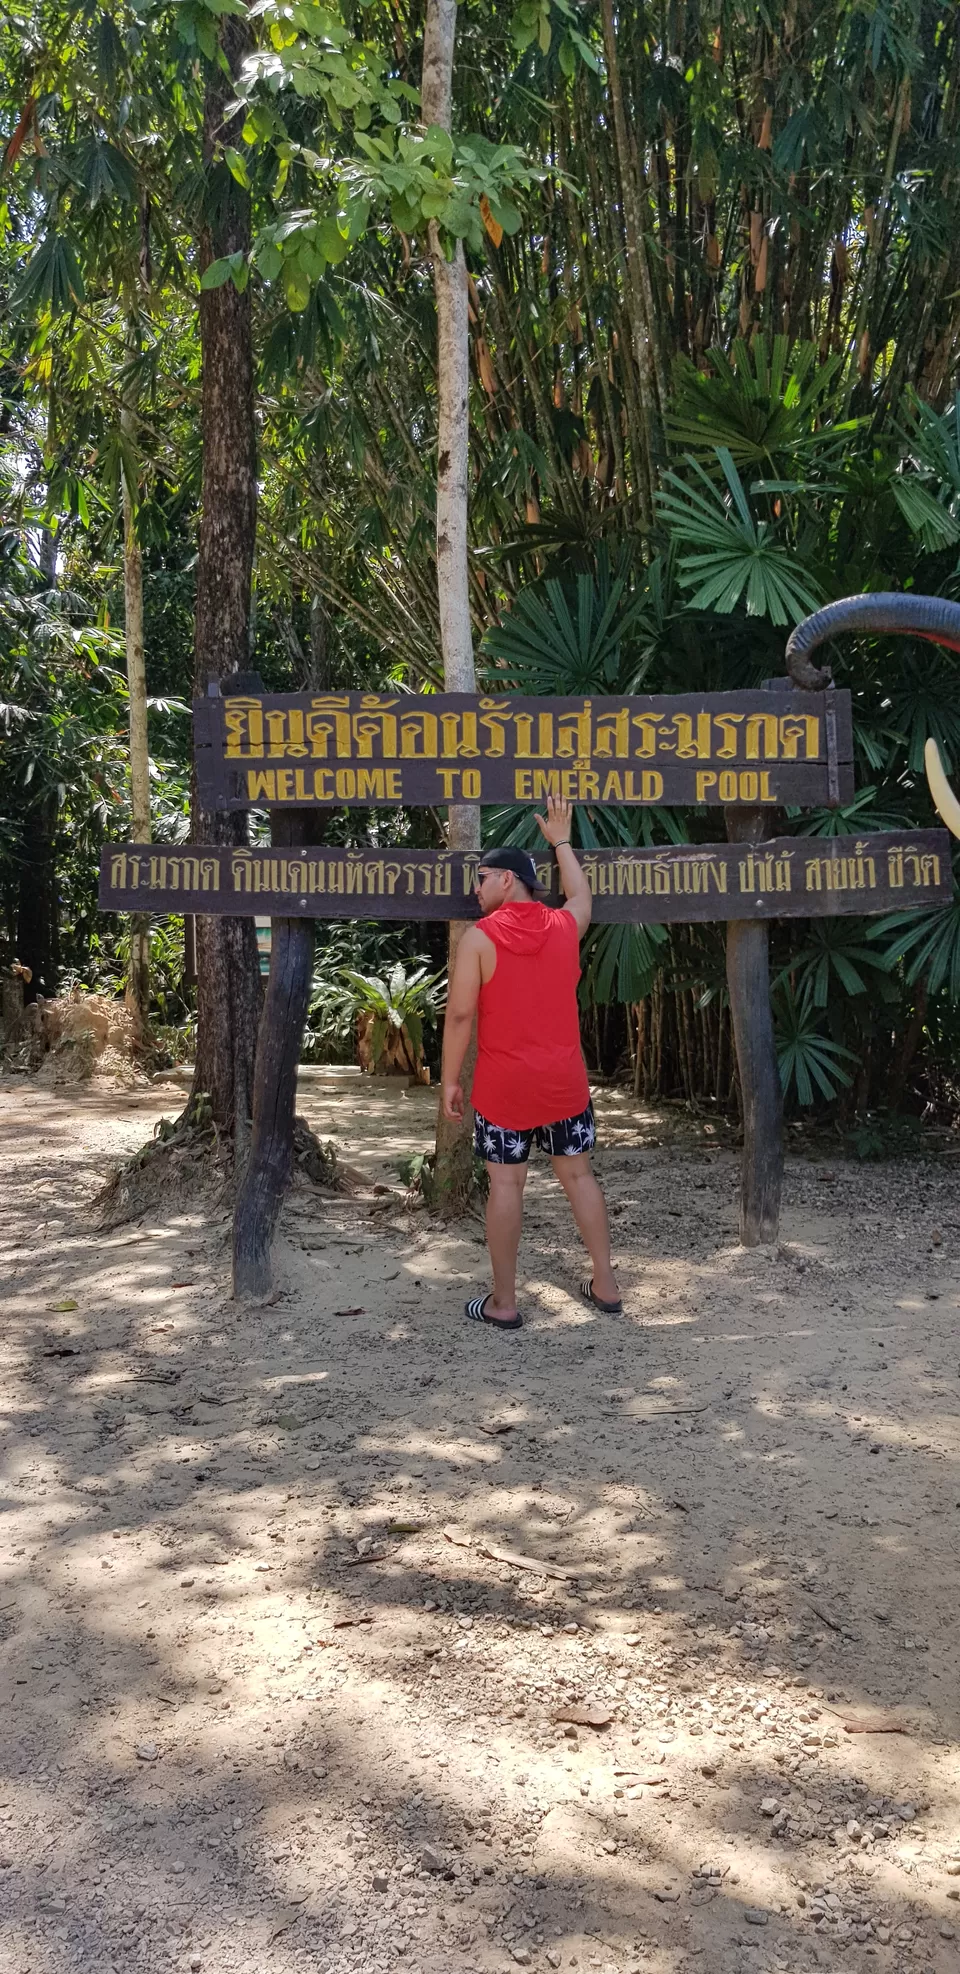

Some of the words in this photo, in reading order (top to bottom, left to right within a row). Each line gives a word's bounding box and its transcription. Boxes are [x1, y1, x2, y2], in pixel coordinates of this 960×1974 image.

[223, 694, 820, 770] ยินดีต้อนรับสู่สระมรกต
[247, 769, 402, 800] WELCOME
[436, 768, 481, 799] TO
[514, 769, 663, 800] EMERALD
[695, 771, 777, 801] POOL
[110, 852, 220, 890] สระมรกต
[231, 849, 452, 895] ดินแดนมหัศจรรย์
[738, 850, 796, 892] ป่าไม้
[805, 841, 876, 891] สายน้ำ
[887, 846, 941, 887] ชีวิต
